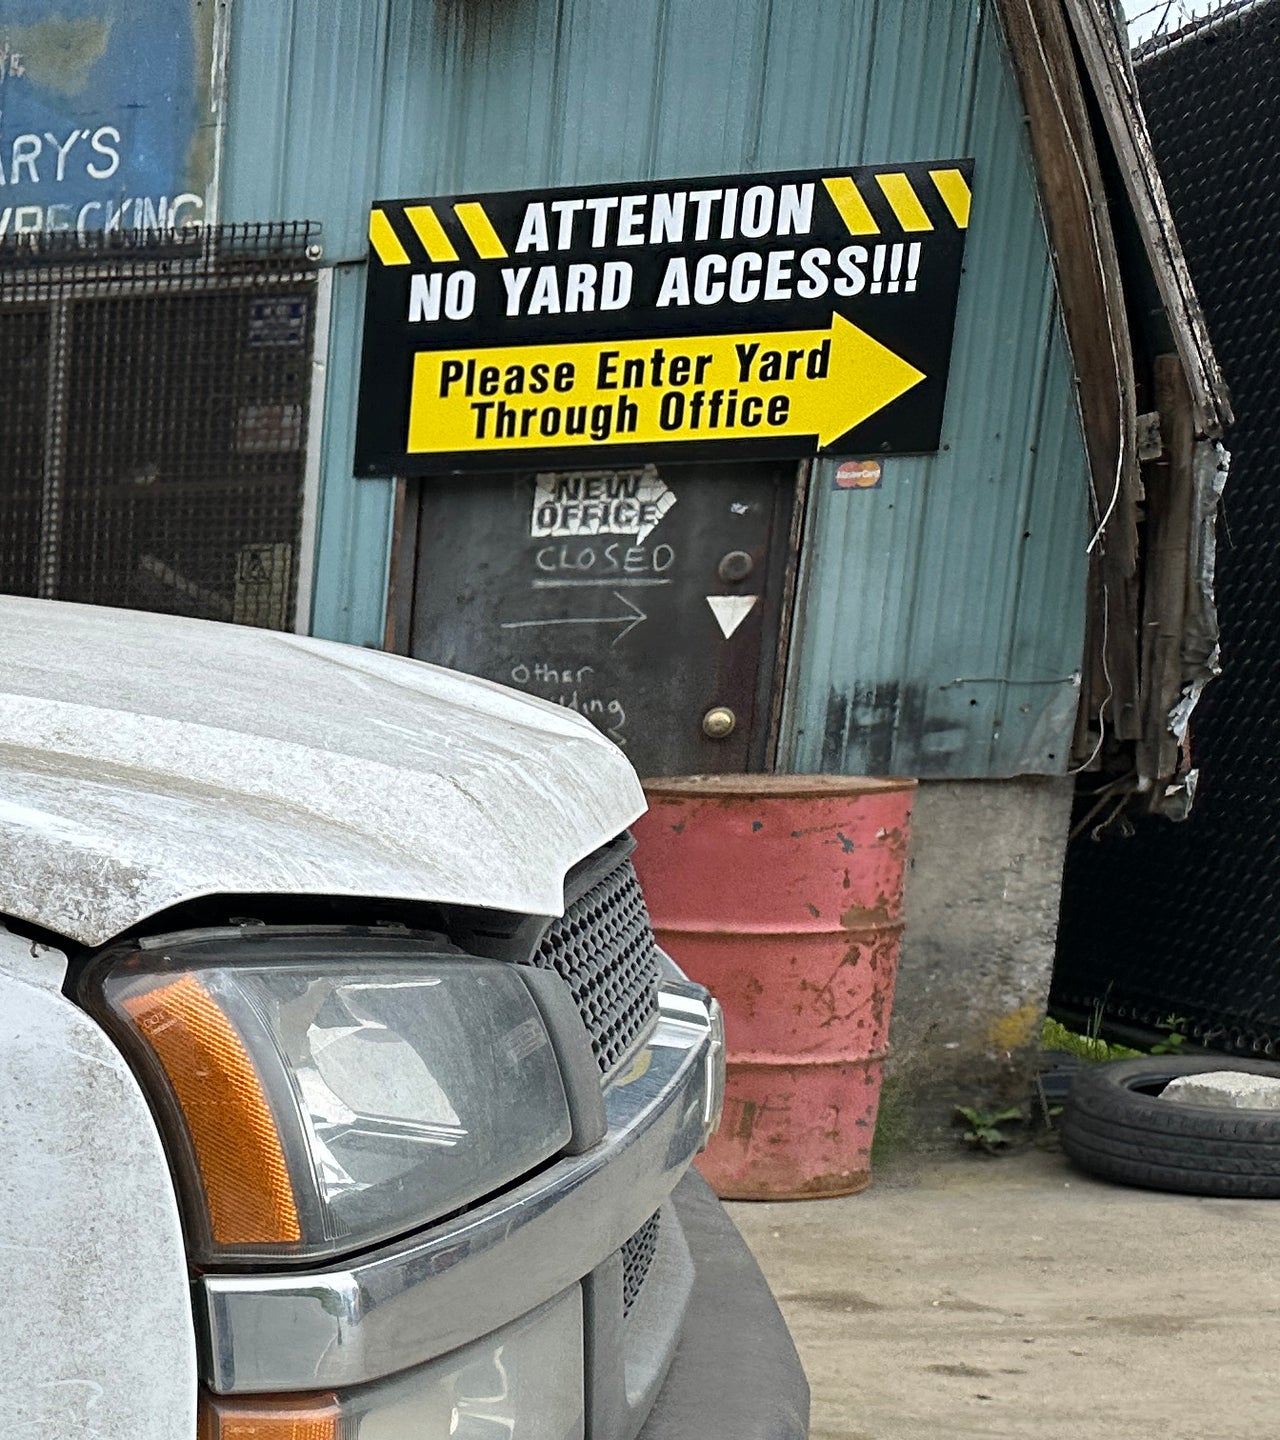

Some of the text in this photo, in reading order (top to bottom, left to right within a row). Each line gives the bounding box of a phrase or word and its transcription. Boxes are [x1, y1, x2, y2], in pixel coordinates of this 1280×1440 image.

[515, 182, 816, 254] ATTENTION
[407, 242, 922, 322] NO YARD ACCESS!!!
[439, 339, 832, 398] Please Enter Yard
[470, 390, 790, 441] Through Office
[554, 476, 640, 500] NEW
[538, 501, 659, 529] OFFICE
[536, 543, 674, 571] CLOSED
